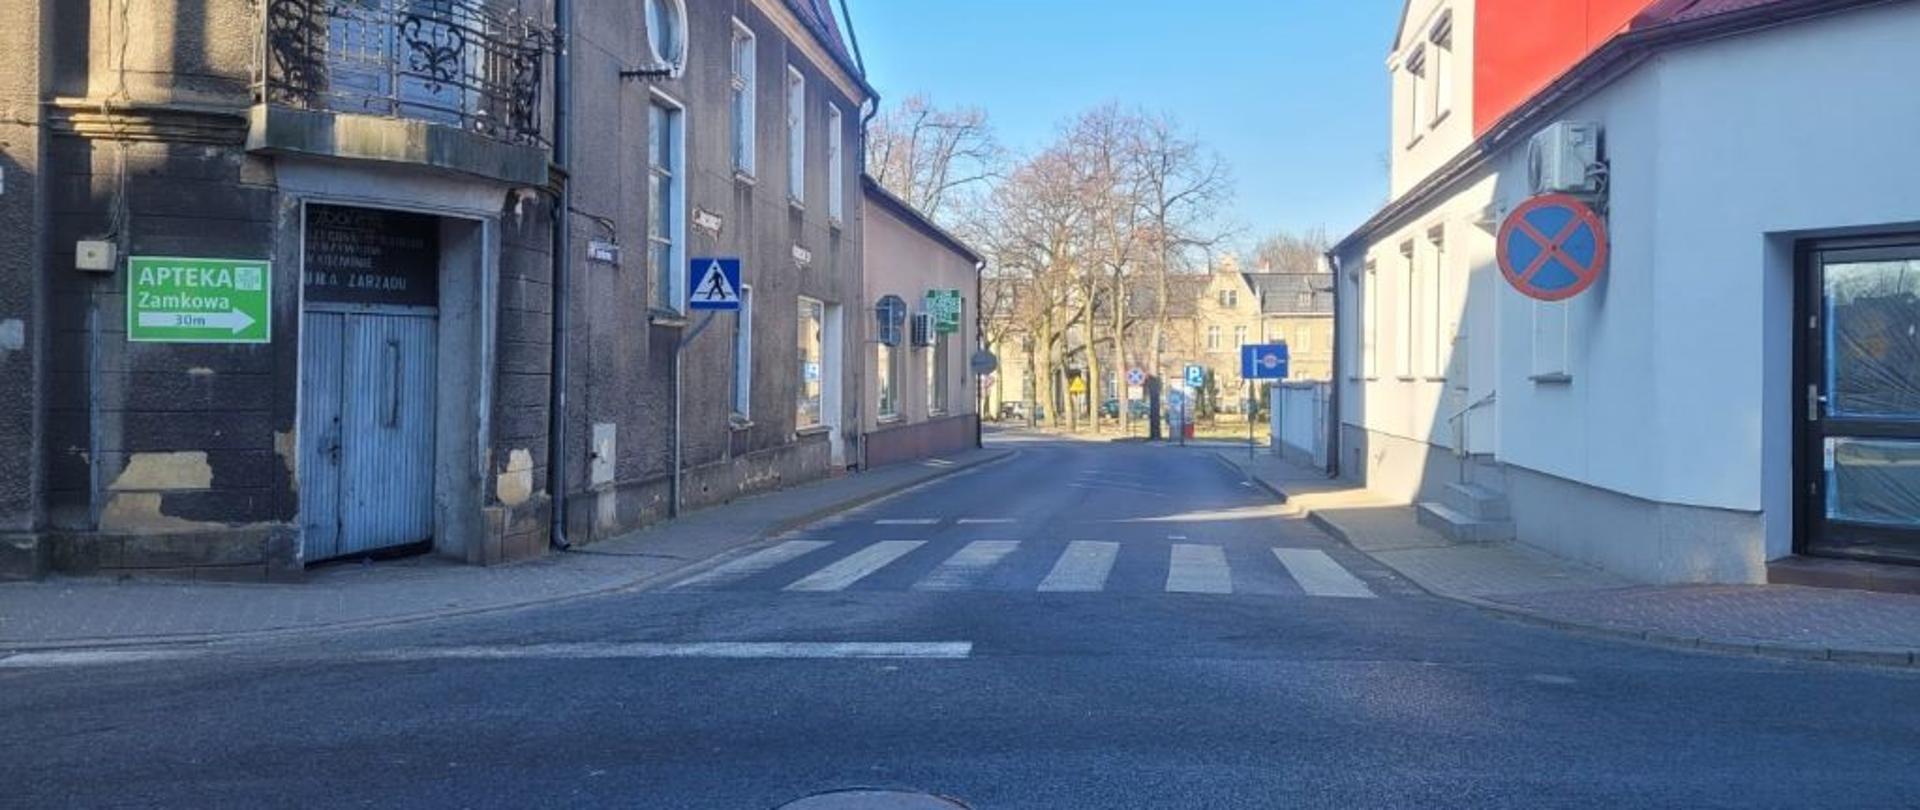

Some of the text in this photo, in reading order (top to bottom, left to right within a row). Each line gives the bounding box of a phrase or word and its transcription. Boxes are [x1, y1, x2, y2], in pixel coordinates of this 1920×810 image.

[139, 266, 233, 288] APTEKA
[138, 291, 230, 309] Zamkowa
[176, 314, 206, 326] 30m
[1189, 367, 1200, 381] P
